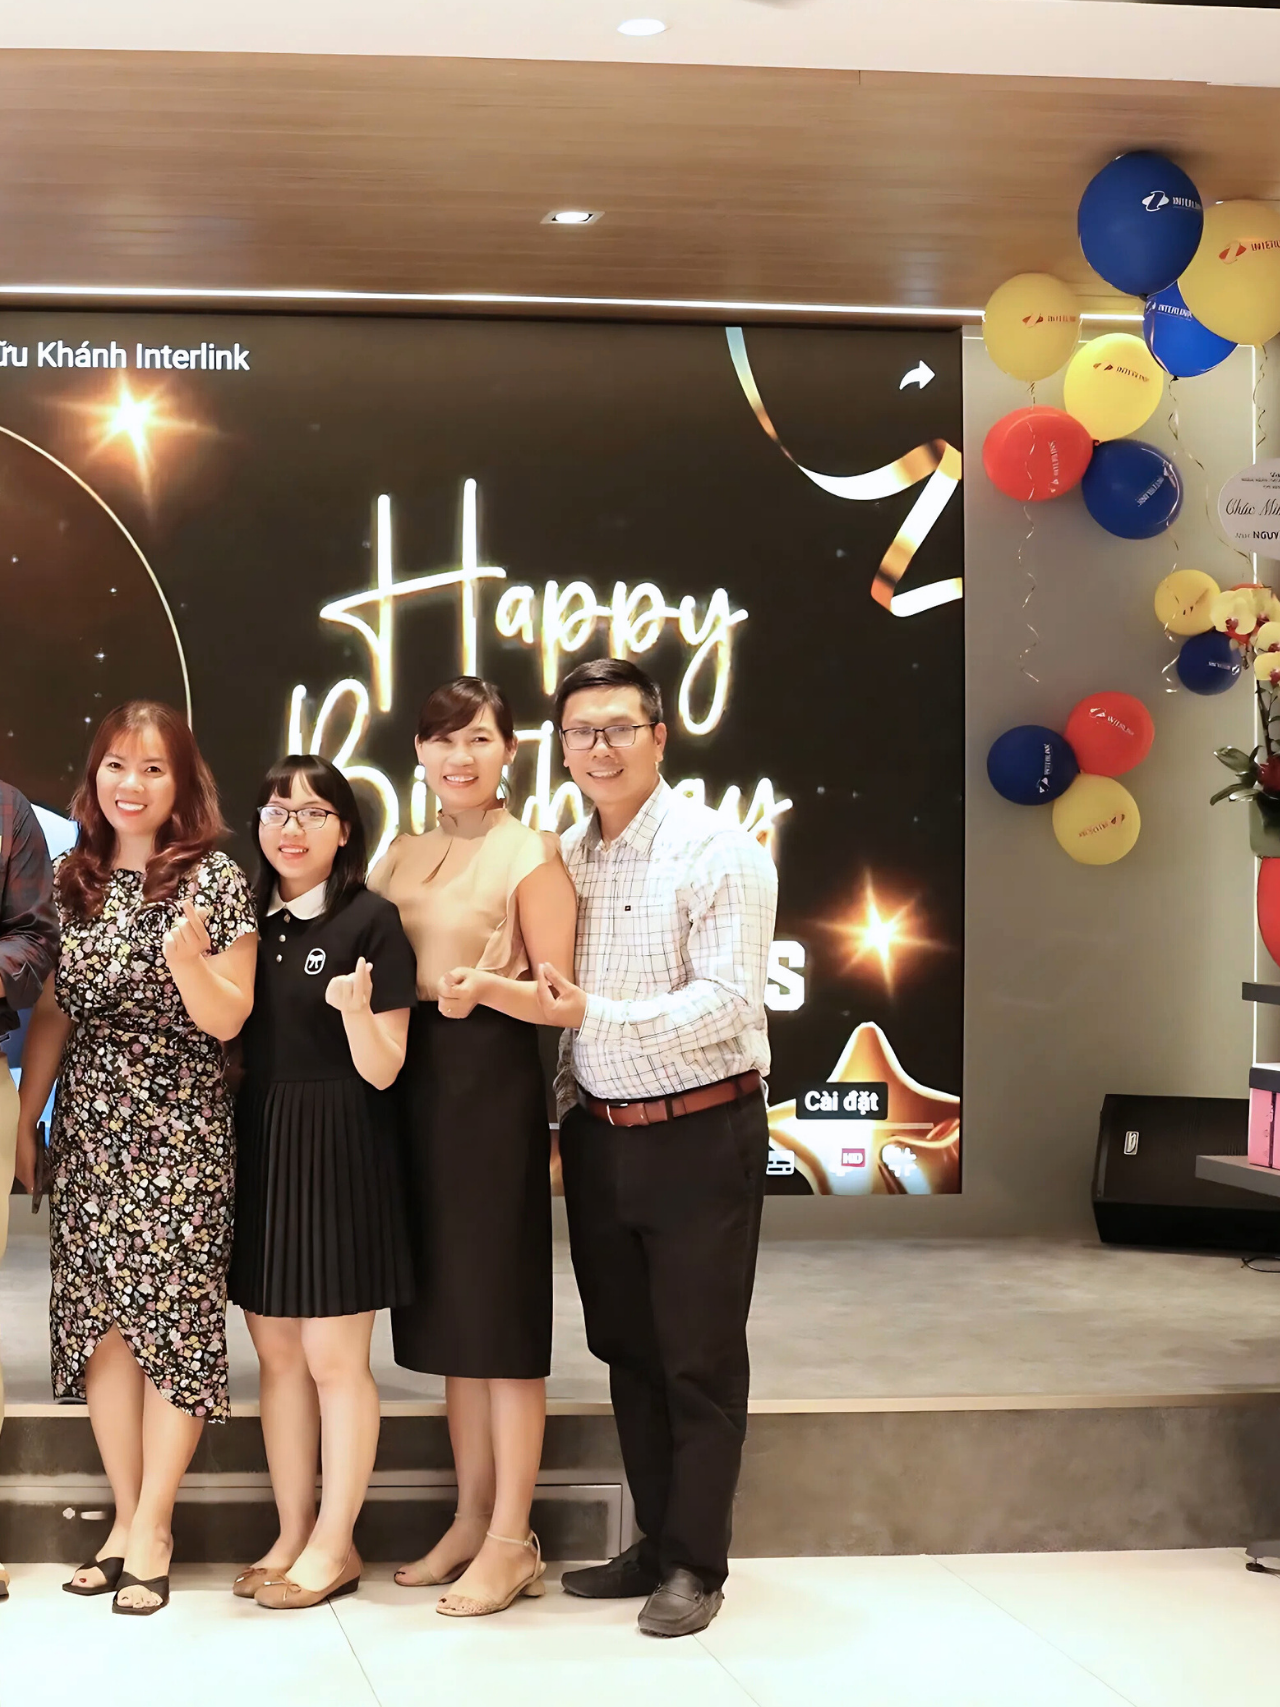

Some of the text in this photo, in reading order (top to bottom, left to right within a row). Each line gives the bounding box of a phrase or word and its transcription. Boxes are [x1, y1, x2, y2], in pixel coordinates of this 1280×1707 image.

[37, 340, 127, 369] Khánh
[136, 342, 251, 371] Interlink
[1253, 530, 1280, 540] NGUY
[319, 478, 749, 735] Happy
[804, 1090, 879, 1115] Cài đặt
